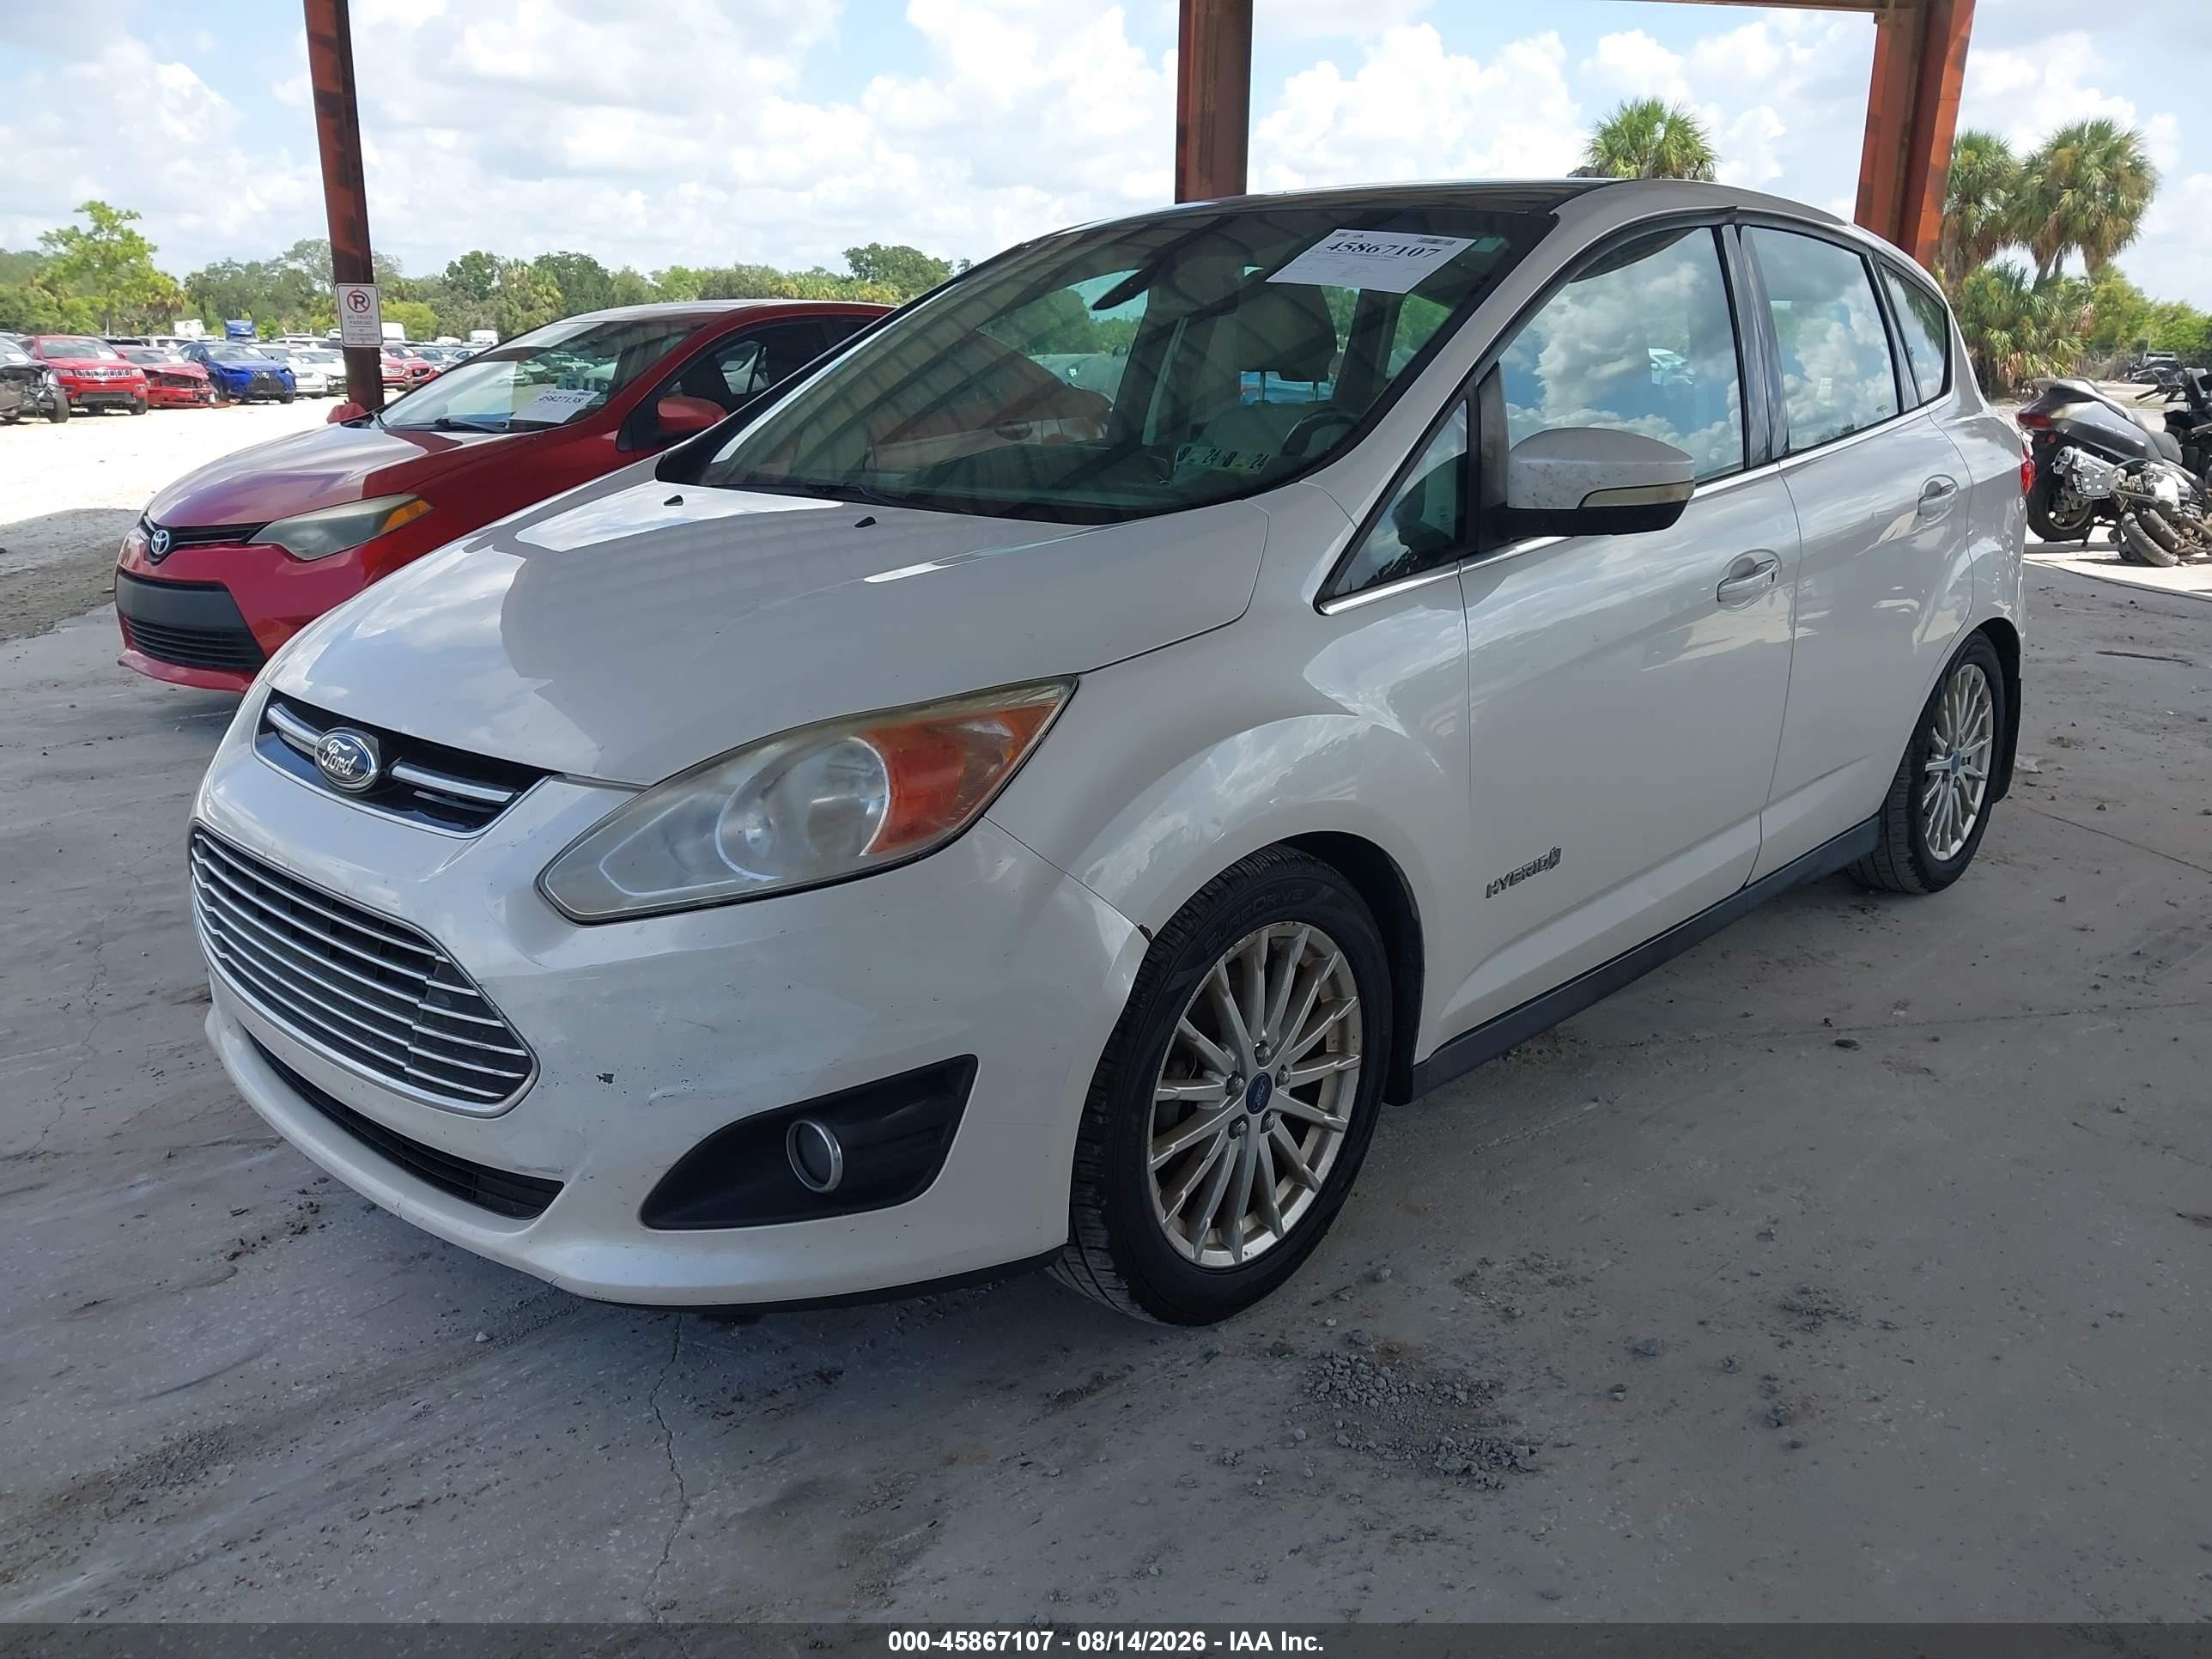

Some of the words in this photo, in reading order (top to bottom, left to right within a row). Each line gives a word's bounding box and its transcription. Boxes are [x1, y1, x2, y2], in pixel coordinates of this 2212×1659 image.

[1326, 240, 1443, 259] 45867107
[321, 738, 358, 775] Ford
[1486, 854, 1551, 899] HYBRID
